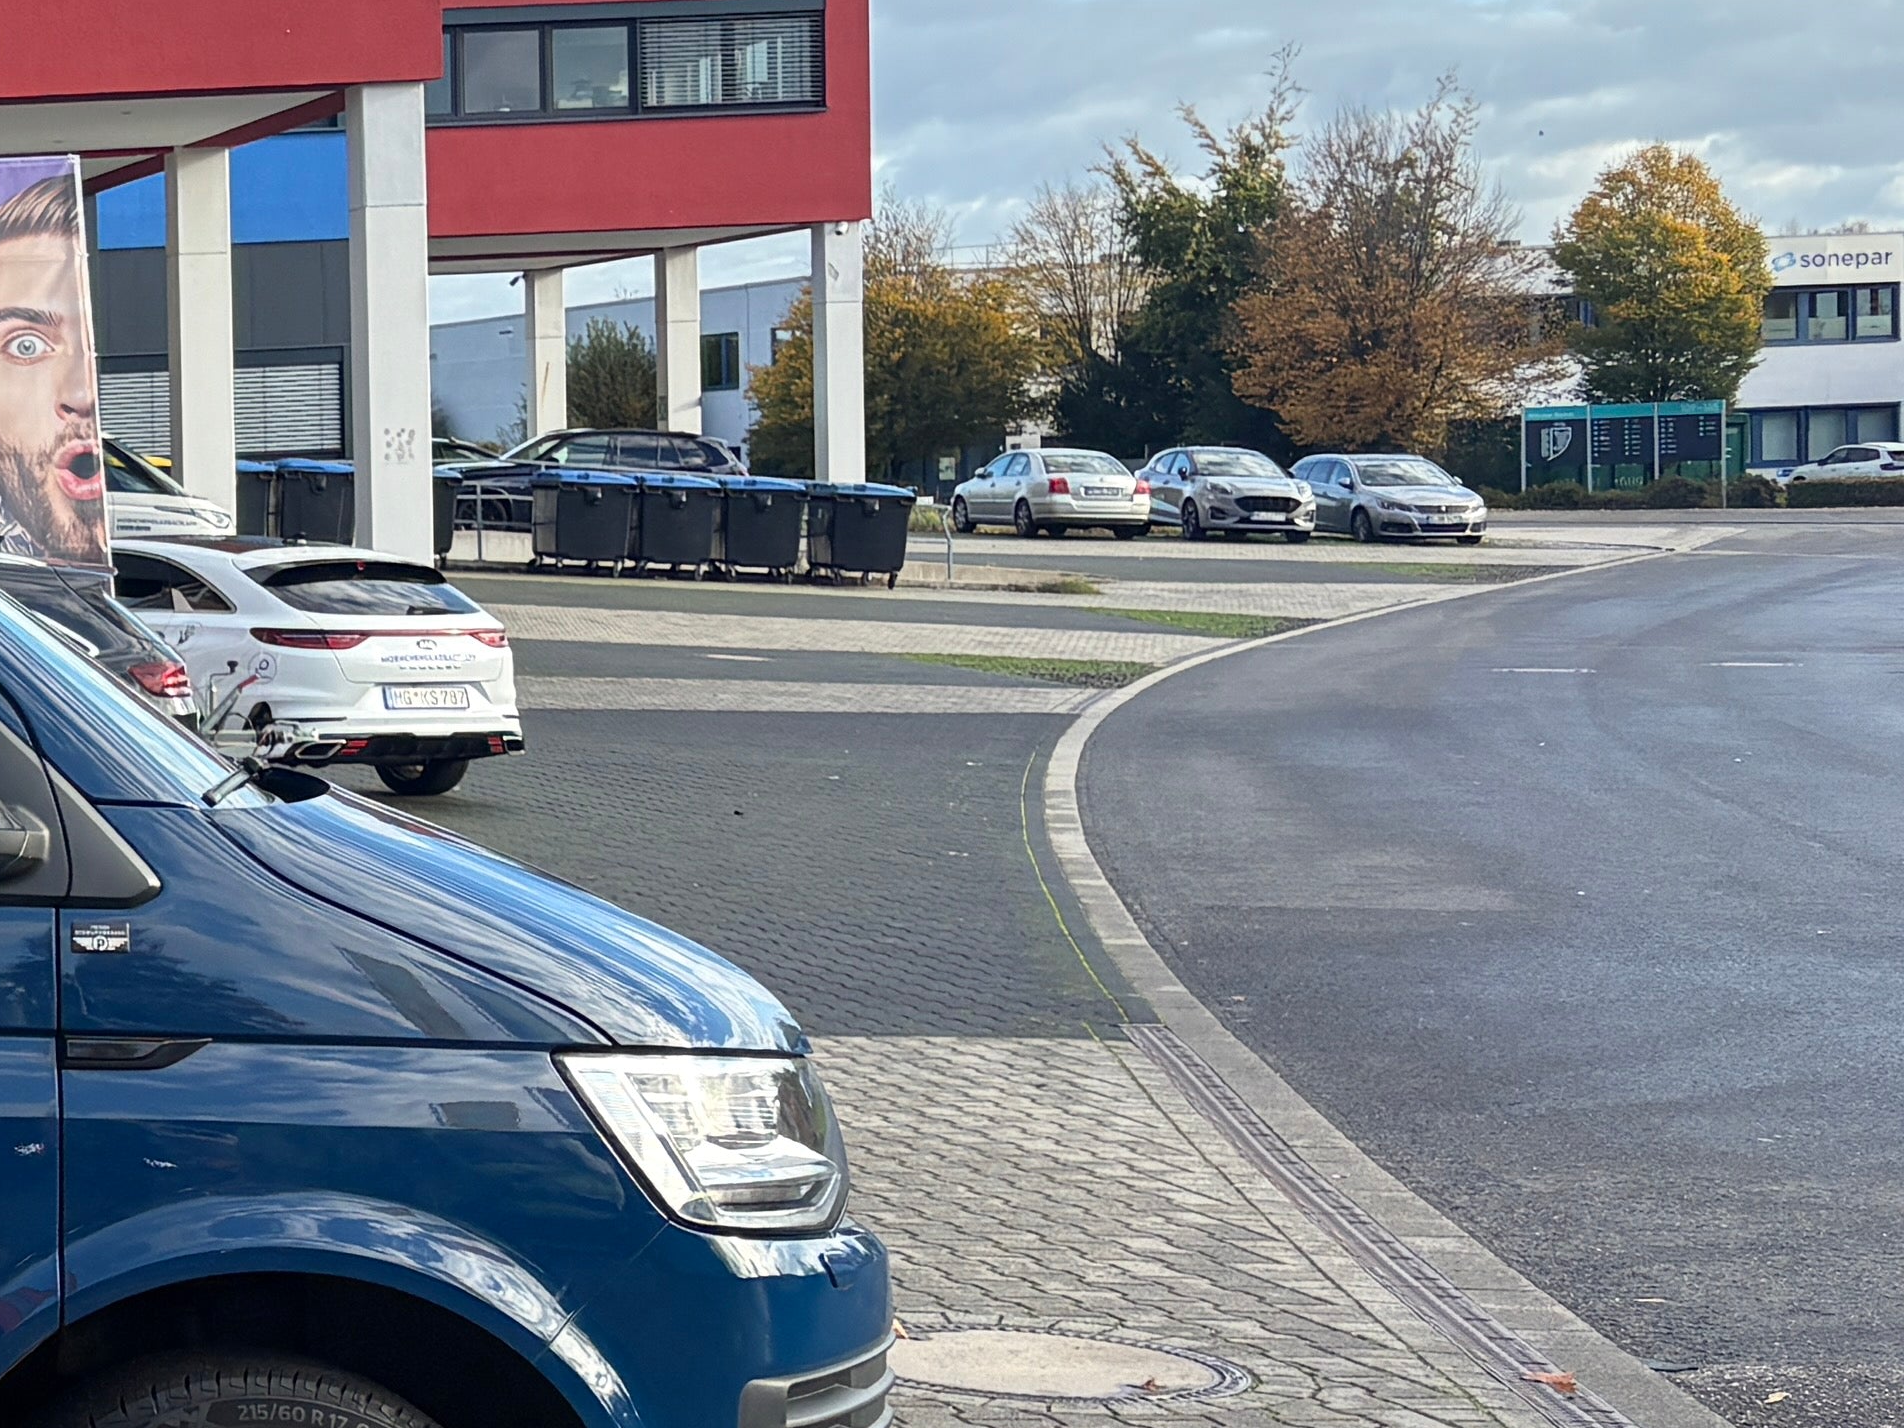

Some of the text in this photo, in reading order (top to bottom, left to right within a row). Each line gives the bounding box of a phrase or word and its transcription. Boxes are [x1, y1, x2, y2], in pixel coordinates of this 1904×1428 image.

[1800, 251, 1893, 269] sonepar
[237, 1403, 306, 1422] 215/60
[311, 1409, 325, 1426] R
